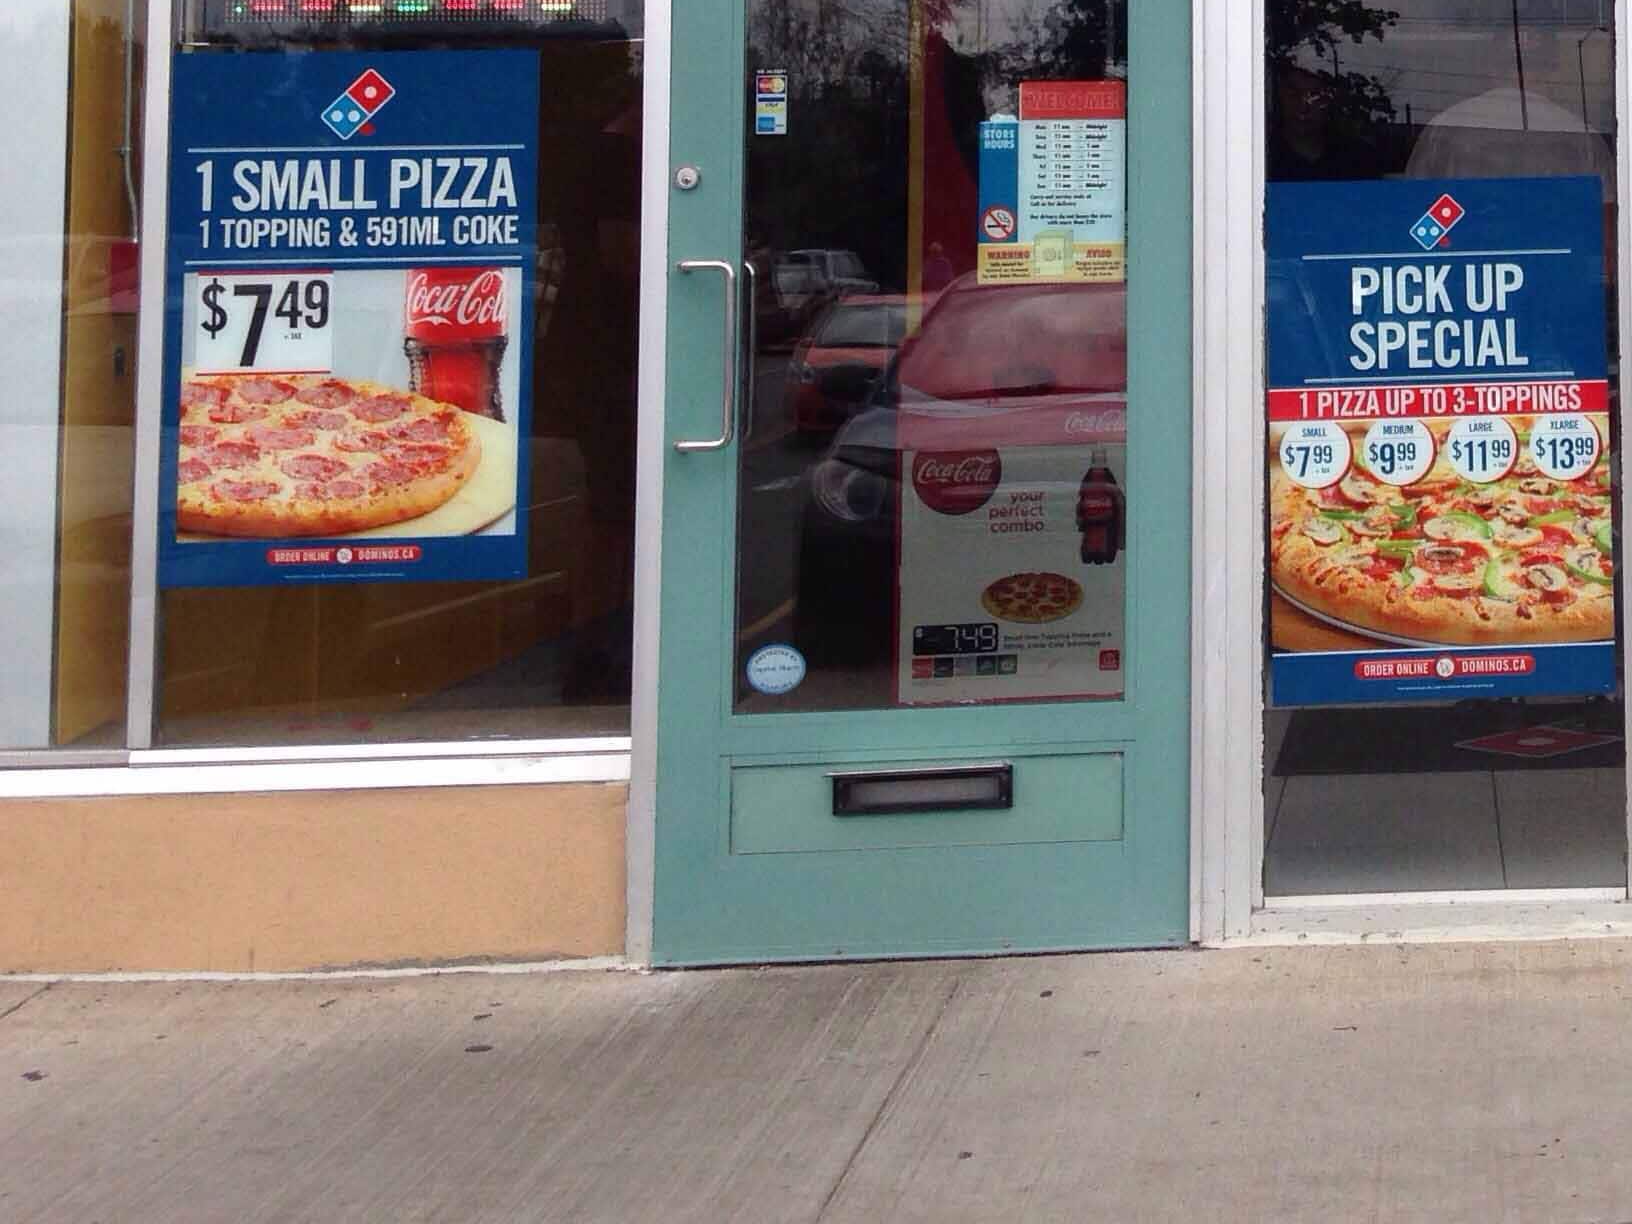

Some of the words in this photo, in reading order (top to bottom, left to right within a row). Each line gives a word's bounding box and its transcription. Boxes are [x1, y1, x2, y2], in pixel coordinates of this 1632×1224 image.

[983, 129, 1014, 139] STORE
[983, 140, 1015, 150] HOURS
[196, 159, 213, 212] 1
[231, 158, 378, 213] SMALL
[389, 156, 518, 209] PIZZA
[200, 218, 209, 249] 1
[220, 216, 331, 250] TOPPING
[339, 216, 358, 247] &
[366, 215, 446, 247] 591ML
[452, 213, 520, 246] COKE
[1351, 264, 1453, 316] PICK
[1465, 263, 1524, 312] UP
[1350, 317, 1529, 372] SPECIAL
[1300, 392, 1309, 418] 1
[1317, 390, 1380, 417] PIZZA
[1386, 389, 1414, 415] UP
[1420, 387, 1446, 414] TO
[1453, 384, 1582, 413] 3-TOPPINGS
[1302, 428, 1327, 437] SMALL
[1383, 425, 1414, 435] MEDIUM
[1469, 422, 1494, 433] LARGE
[917, 456, 994, 484] Coca-Cola
[1009, 491, 1044, 505] your
[989, 504, 1044, 520] perfect
[990, 520, 1044, 533] combo
[274, 552, 301, 563] ORDER
[303, 551, 330, 562] ONLINE
[1363, 664, 1394, 676] ORDER
[1397, 662, 1429, 675] ONLINE
[1462, 658, 1527, 672] DOMINOS.CA
